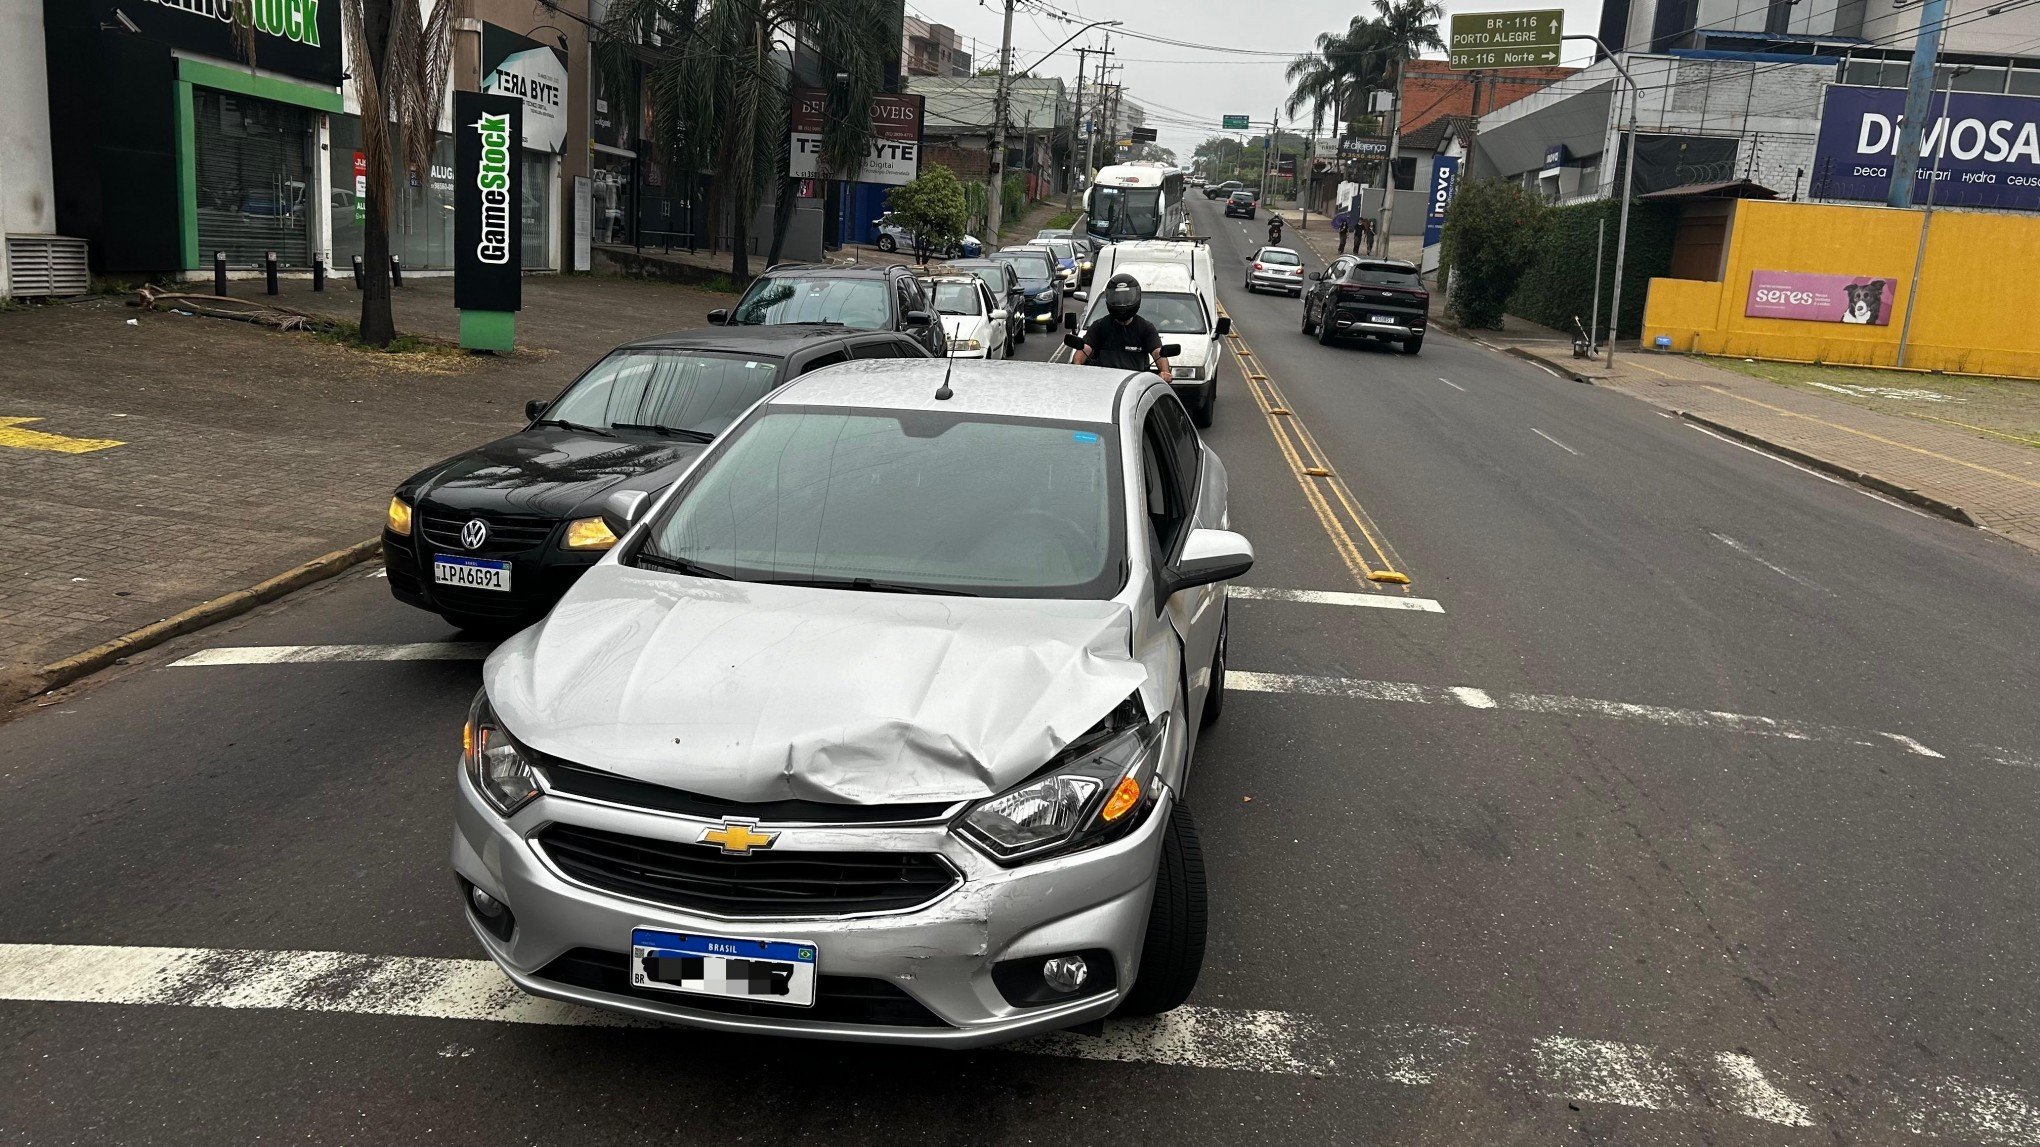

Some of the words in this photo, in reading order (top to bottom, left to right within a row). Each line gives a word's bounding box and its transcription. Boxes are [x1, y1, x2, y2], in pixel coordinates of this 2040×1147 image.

[1453, 33, 1490, 44] PORTO
[1494, 31, 1536, 42] ALEGRE
[1452, 54, 1495, 65] BR-116
[1504, 52, 1534, 62] Norte
[496, 68, 527, 98] TERA
[530, 79, 558, 106] BYTE
[869, 100, 914, 120] ÓVEIS
[1854, 166, 1888, 178] Deca
[478, 112, 510, 264] GameStock
[1430, 166, 1450, 218] inova
[1756, 289, 1812, 305] seres
[440, 564, 502, 588] IPA6G91
[708, 942, 738, 954] BRASIL
[634, 974, 645, 985] BR
